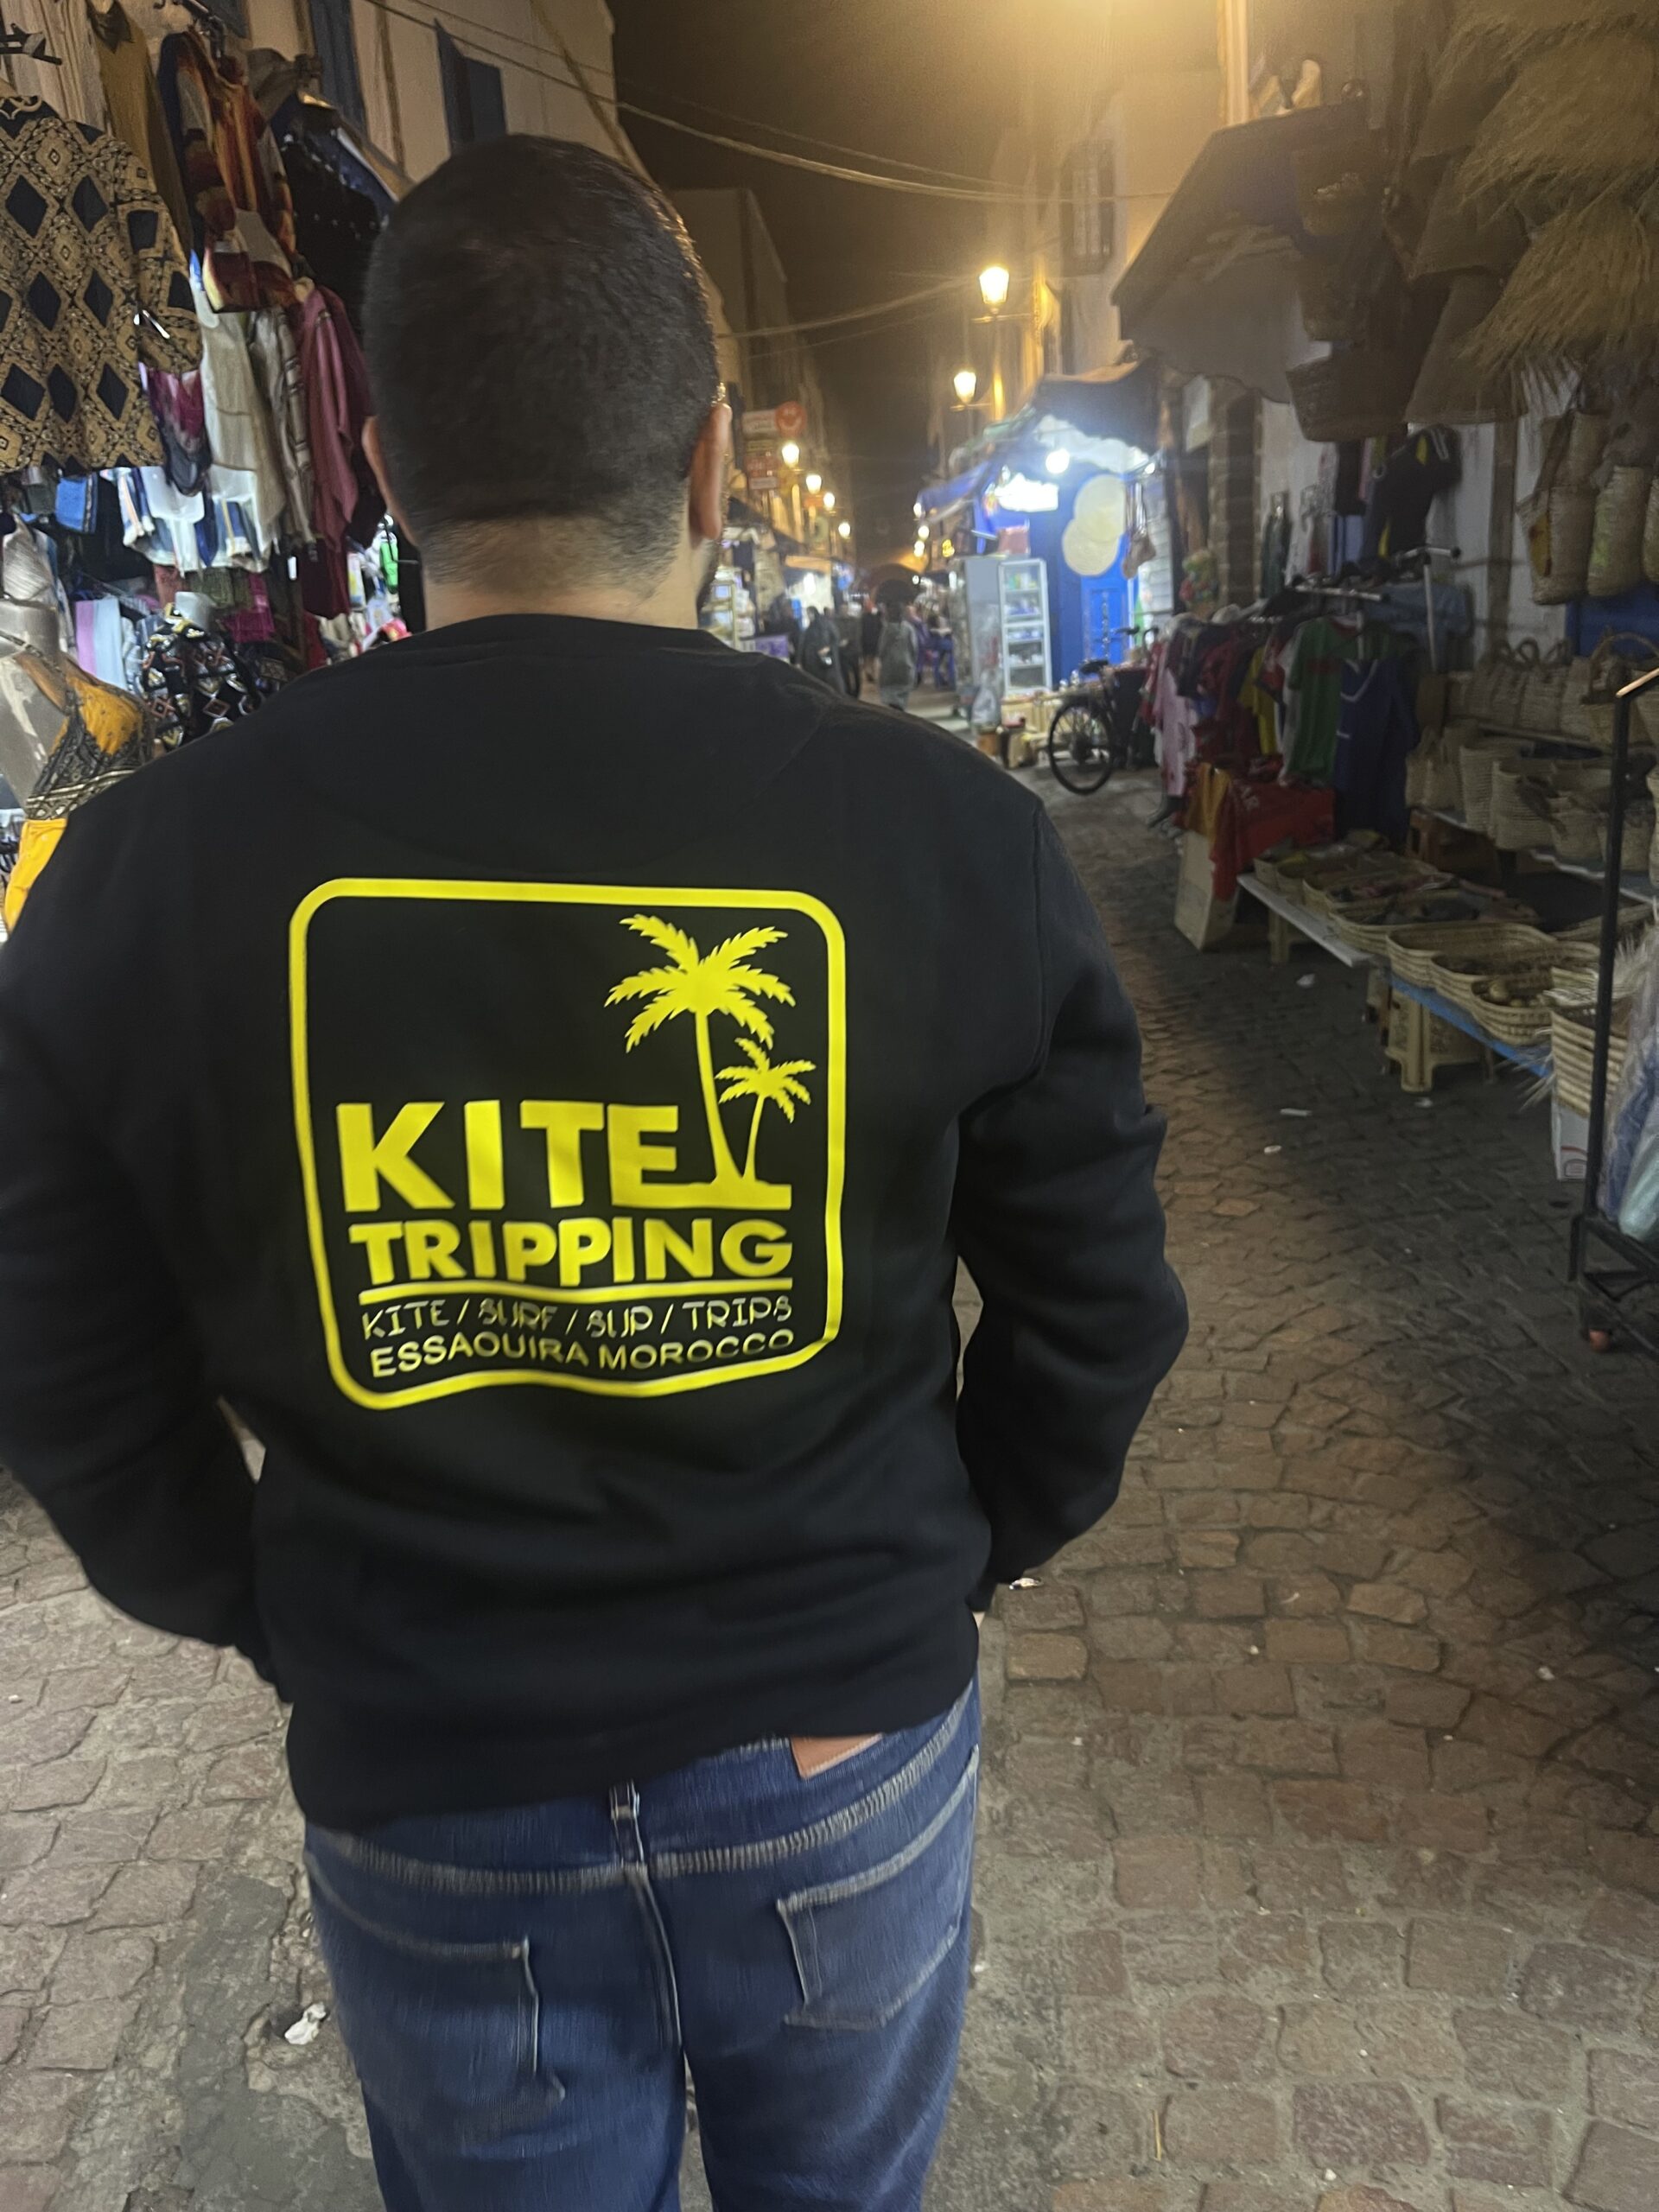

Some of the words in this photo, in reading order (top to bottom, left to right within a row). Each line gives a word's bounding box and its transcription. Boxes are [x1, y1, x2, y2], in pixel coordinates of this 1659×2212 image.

[336, 1100, 791, 1211] KITE
[349, 1217, 793, 1287] TRIPPING
[363, 1300, 449, 1339] KITE
[478, 1299, 558, 1328] SURF
[588, 1306, 652, 1338] SUP
[683, 1296, 792, 1328] TRIPS
[370, 1332, 589, 1377] ESSAOUIRA
[600, 1329, 794, 1370] MOROCCO
